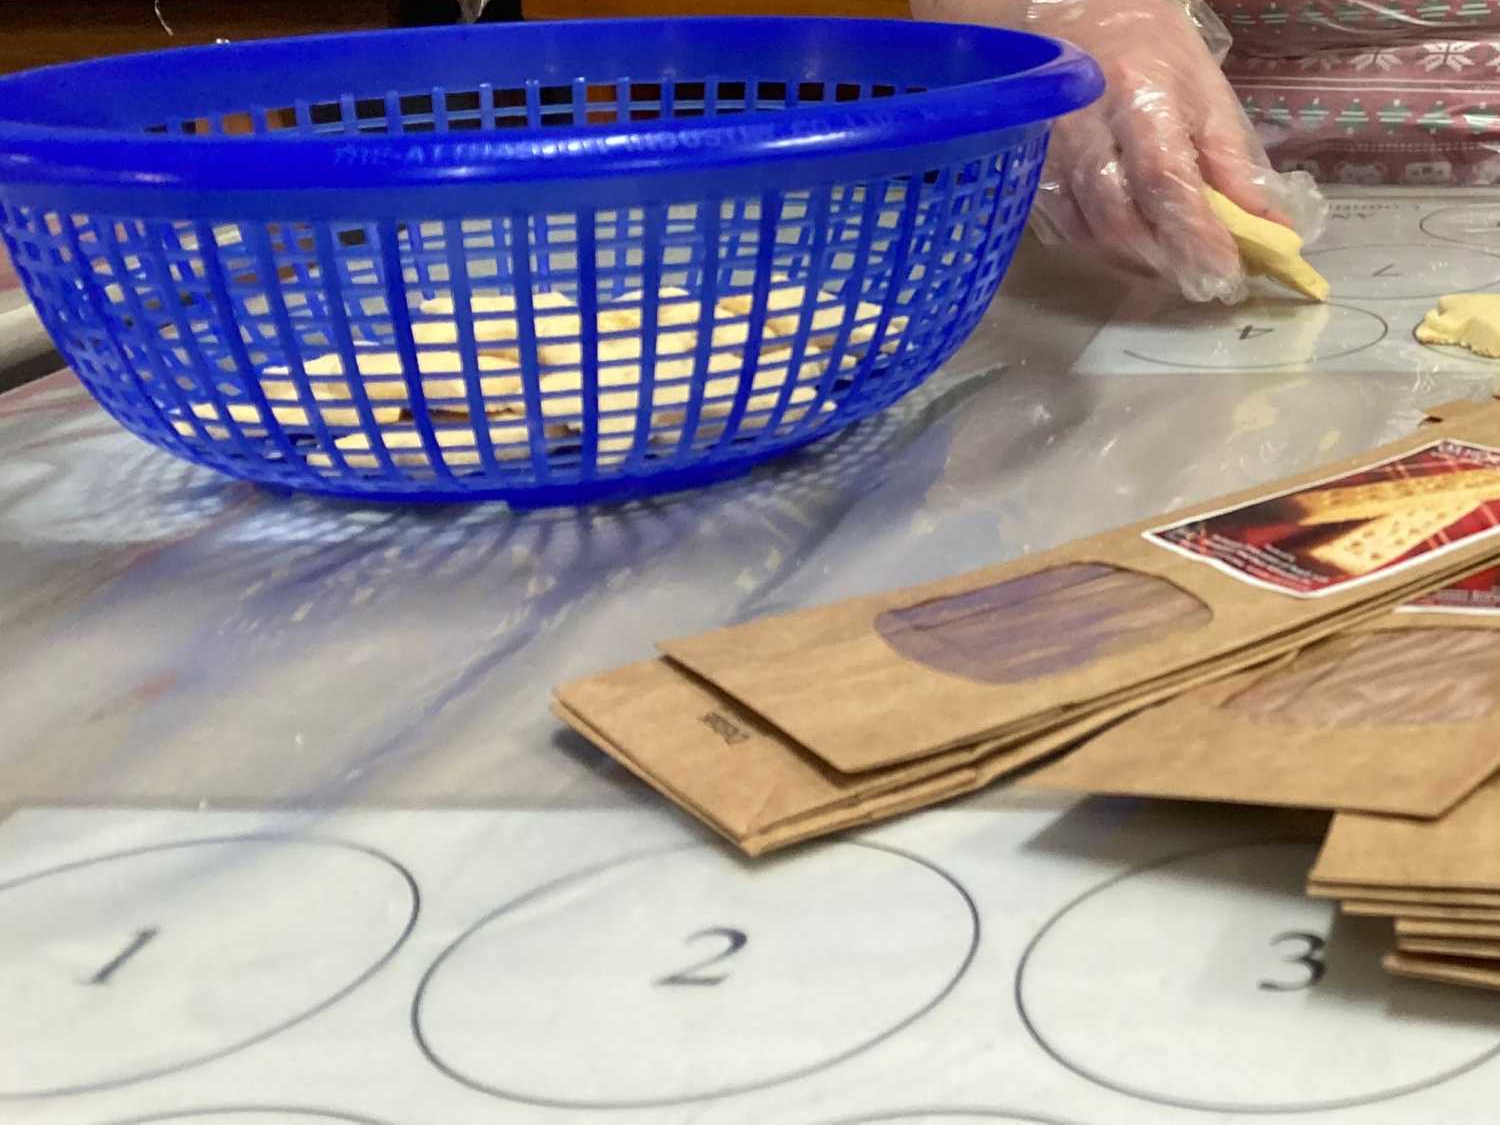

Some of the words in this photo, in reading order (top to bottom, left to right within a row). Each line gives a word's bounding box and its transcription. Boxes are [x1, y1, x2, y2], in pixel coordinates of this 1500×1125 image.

[1238, 324, 1276, 341] 4
[74, 925, 160, 986] 1
[650, 925, 748, 987] 2
[1257, 929, 1327, 992] 3
